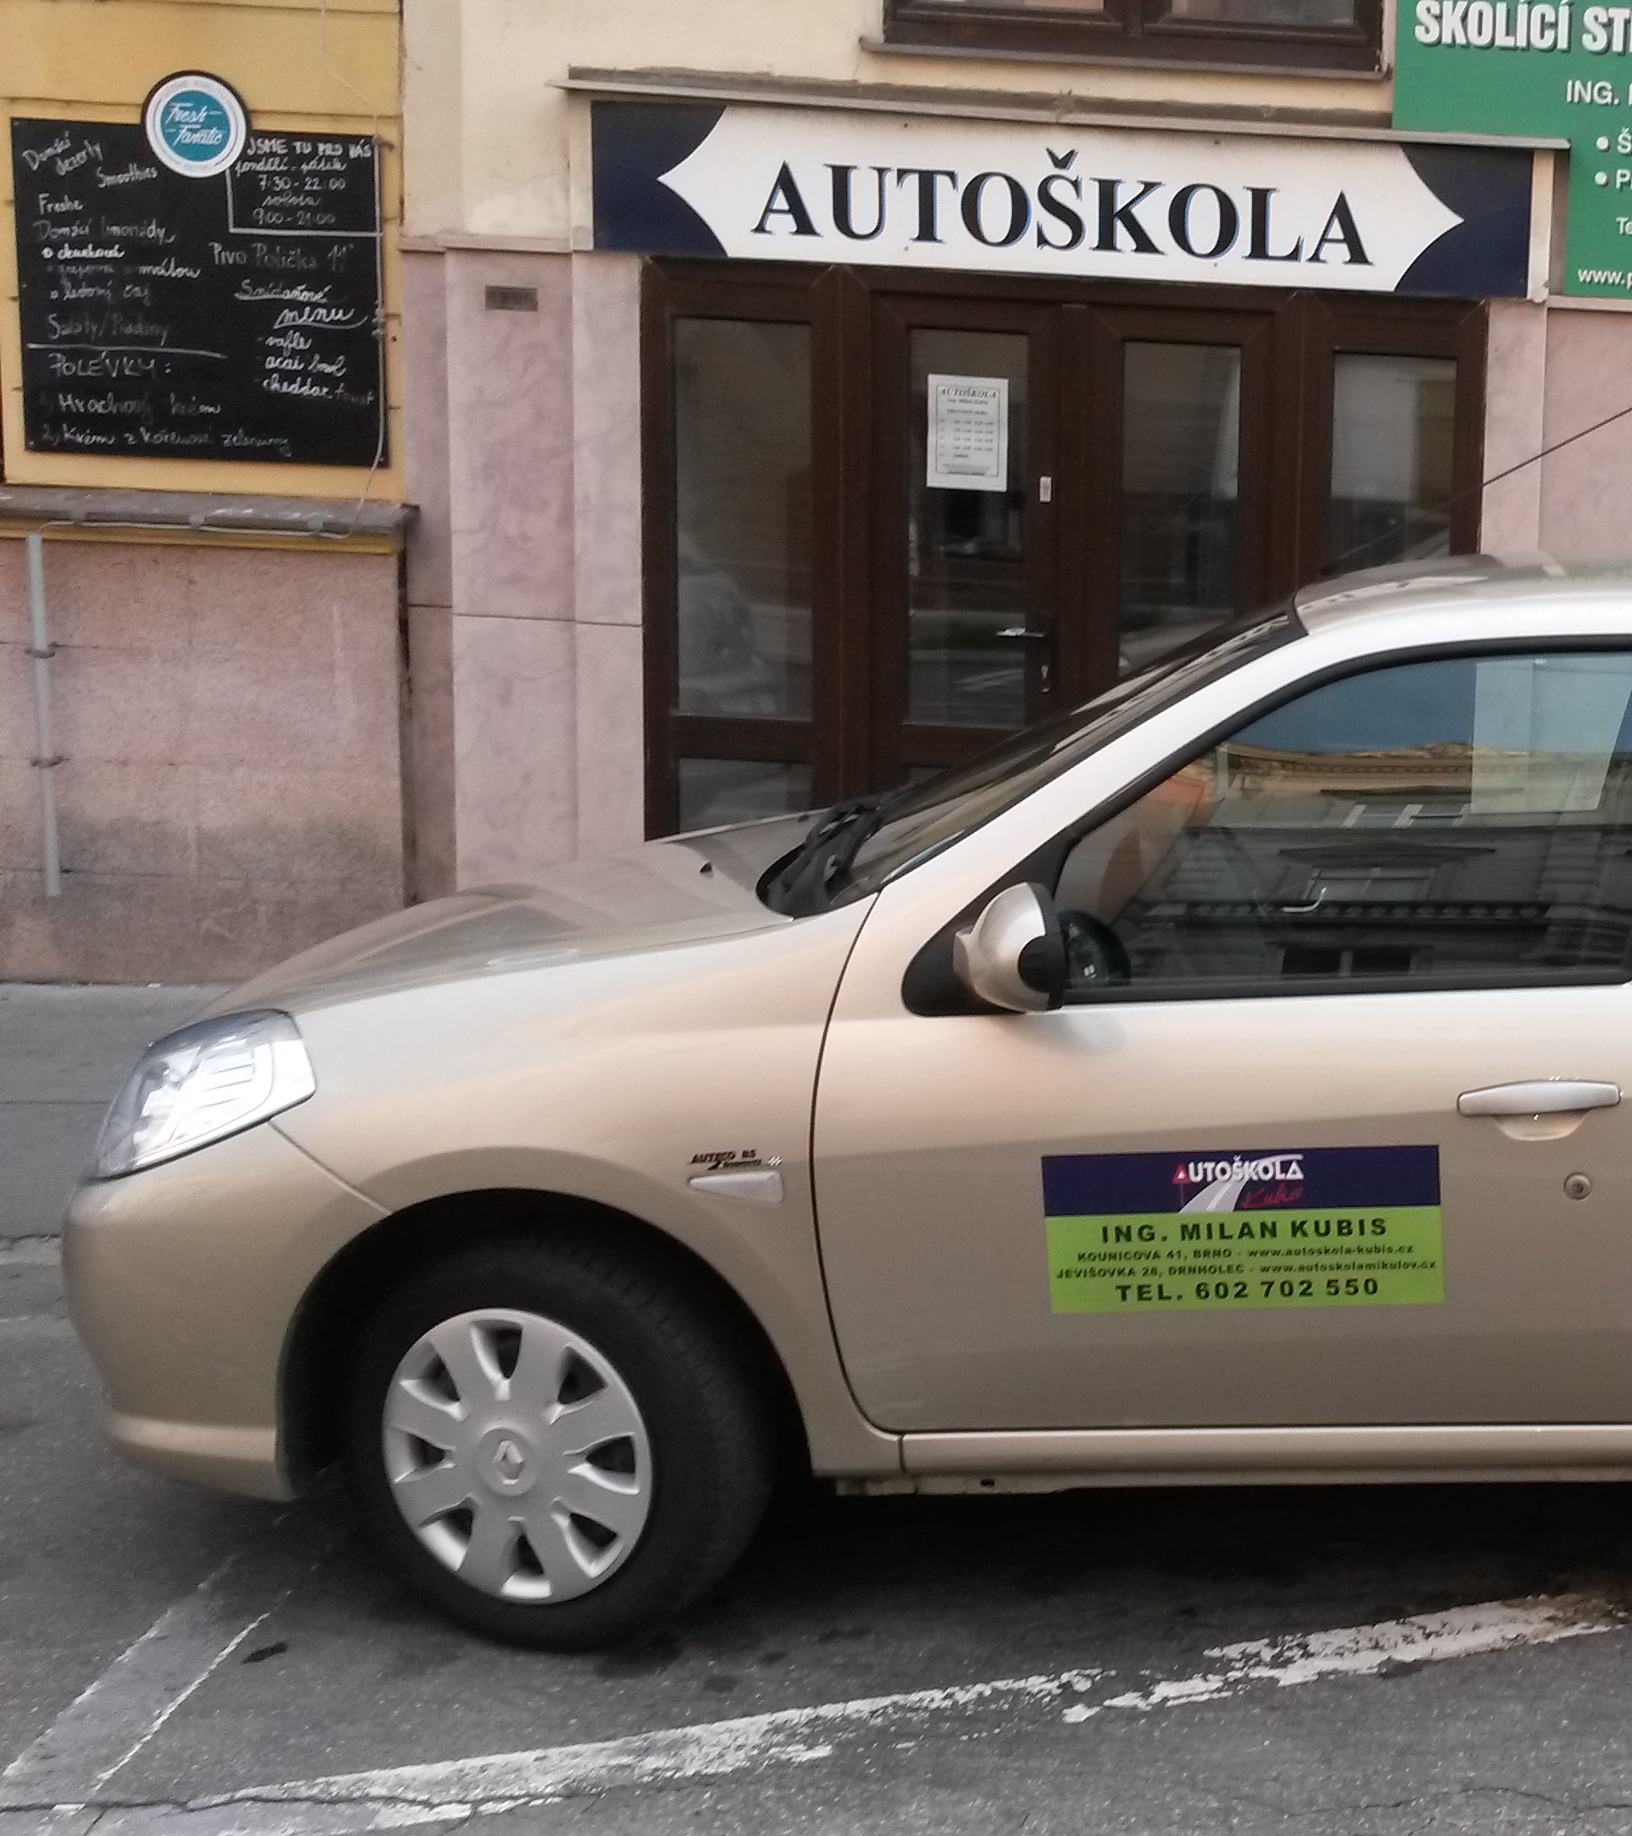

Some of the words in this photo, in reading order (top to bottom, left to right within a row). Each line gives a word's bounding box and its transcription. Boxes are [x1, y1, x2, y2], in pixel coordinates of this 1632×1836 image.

[1565, 79, 1620, 106] ING.
[165, 102, 208, 125] Fresh
[173, 124, 224, 147] Fanatic
[247, 138, 288, 156] JSME
[348, 139, 372, 159] VÁS
[751, 147, 1375, 266] AUTOŠKOLA
[1101, 1225, 1168, 1244] ING.
[1180, 1220, 1278, 1241] MILAN
[1290, 1217, 1388, 1239] KUBIS
[1077, 1250, 1161, 1263] KOUNICOVA
[1166, 1249, 1188, 1261] 41,
[1193, 1248, 1232, 1259] BRNO
[1114, 1283, 1184, 1302] TEL.
[1195, 1281, 1249, 1300] 602
[1259, 1279, 1313, 1298] 702
[1325, 1277, 1379, 1297] 550
